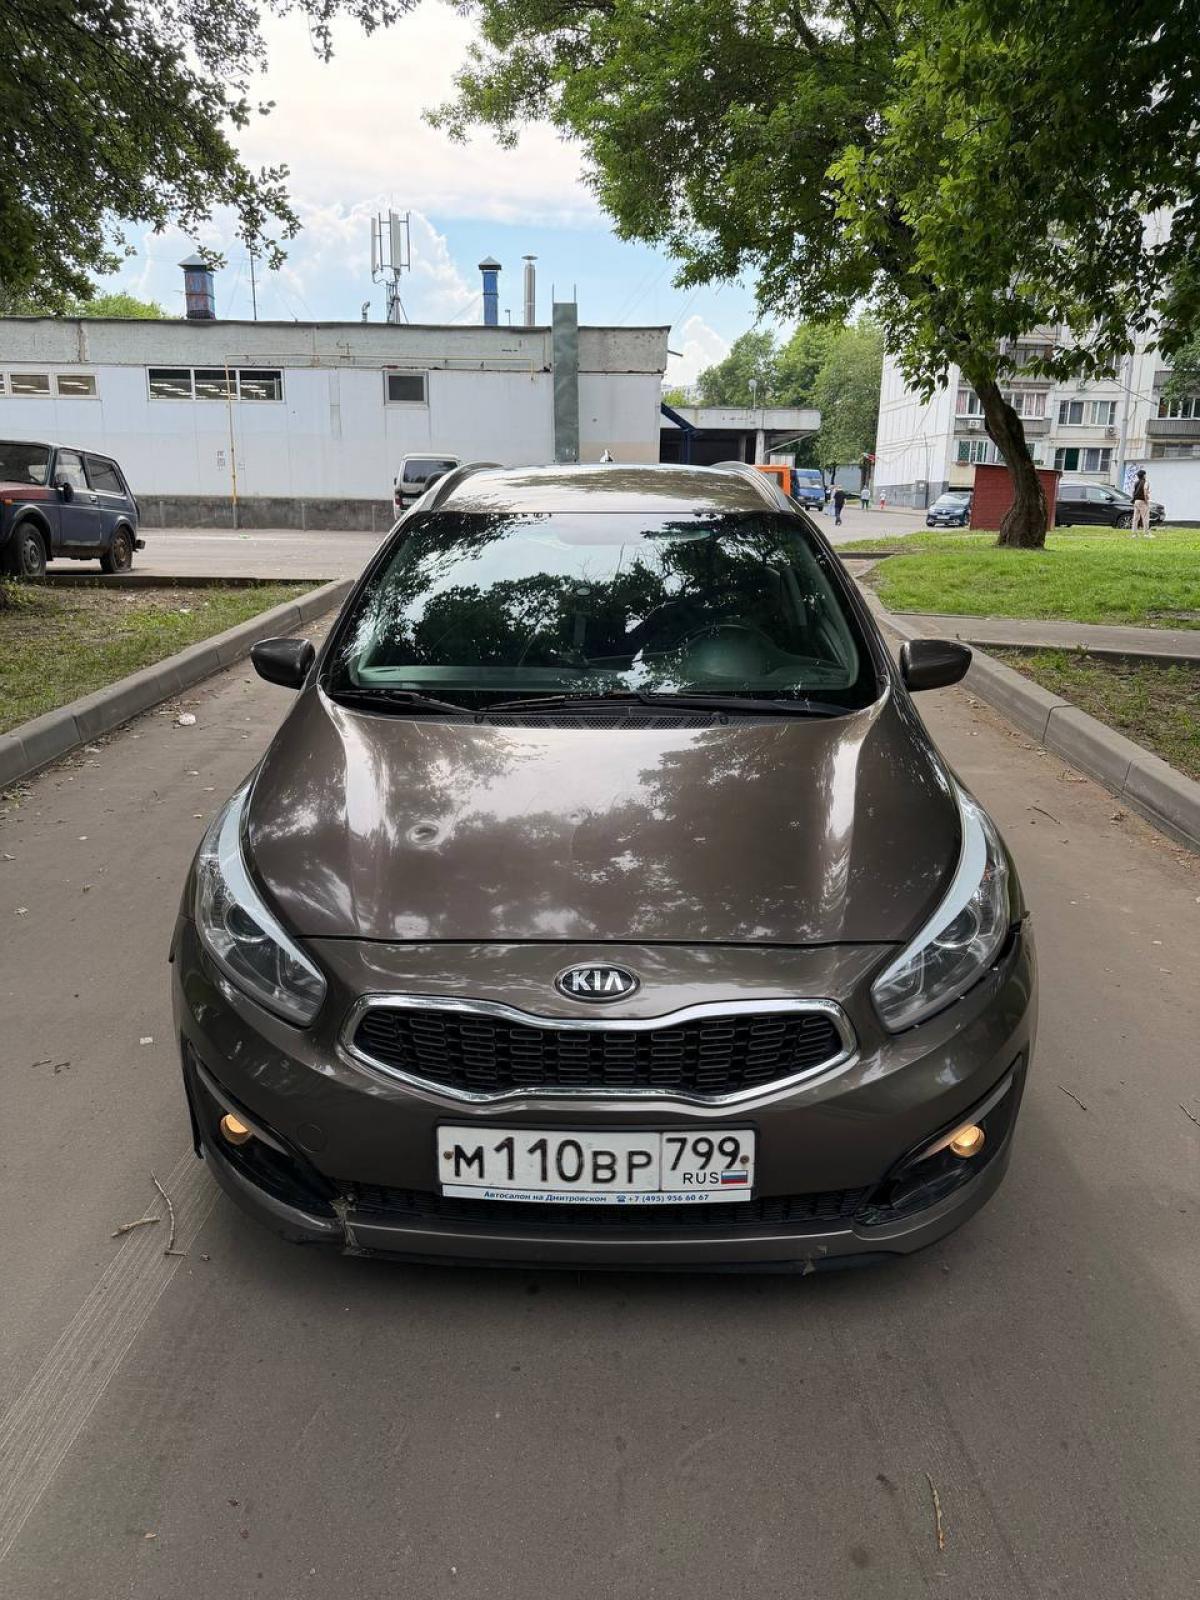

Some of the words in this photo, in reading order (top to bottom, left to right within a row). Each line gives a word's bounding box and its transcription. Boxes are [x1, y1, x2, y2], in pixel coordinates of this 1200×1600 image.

[571, 970, 625, 991] KIA
[665, 1136, 741, 1171] 799
[682, 1171, 719, 1185] RUS
[484, 1190, 531, 1201] Автосалон
[545, 1194, 607, 1203] Дмитровском
[642, 1195, 665, 1203] (495)
[667, 1194, 683, 1202] 956
[685, 1194, 696, 1202] 60
